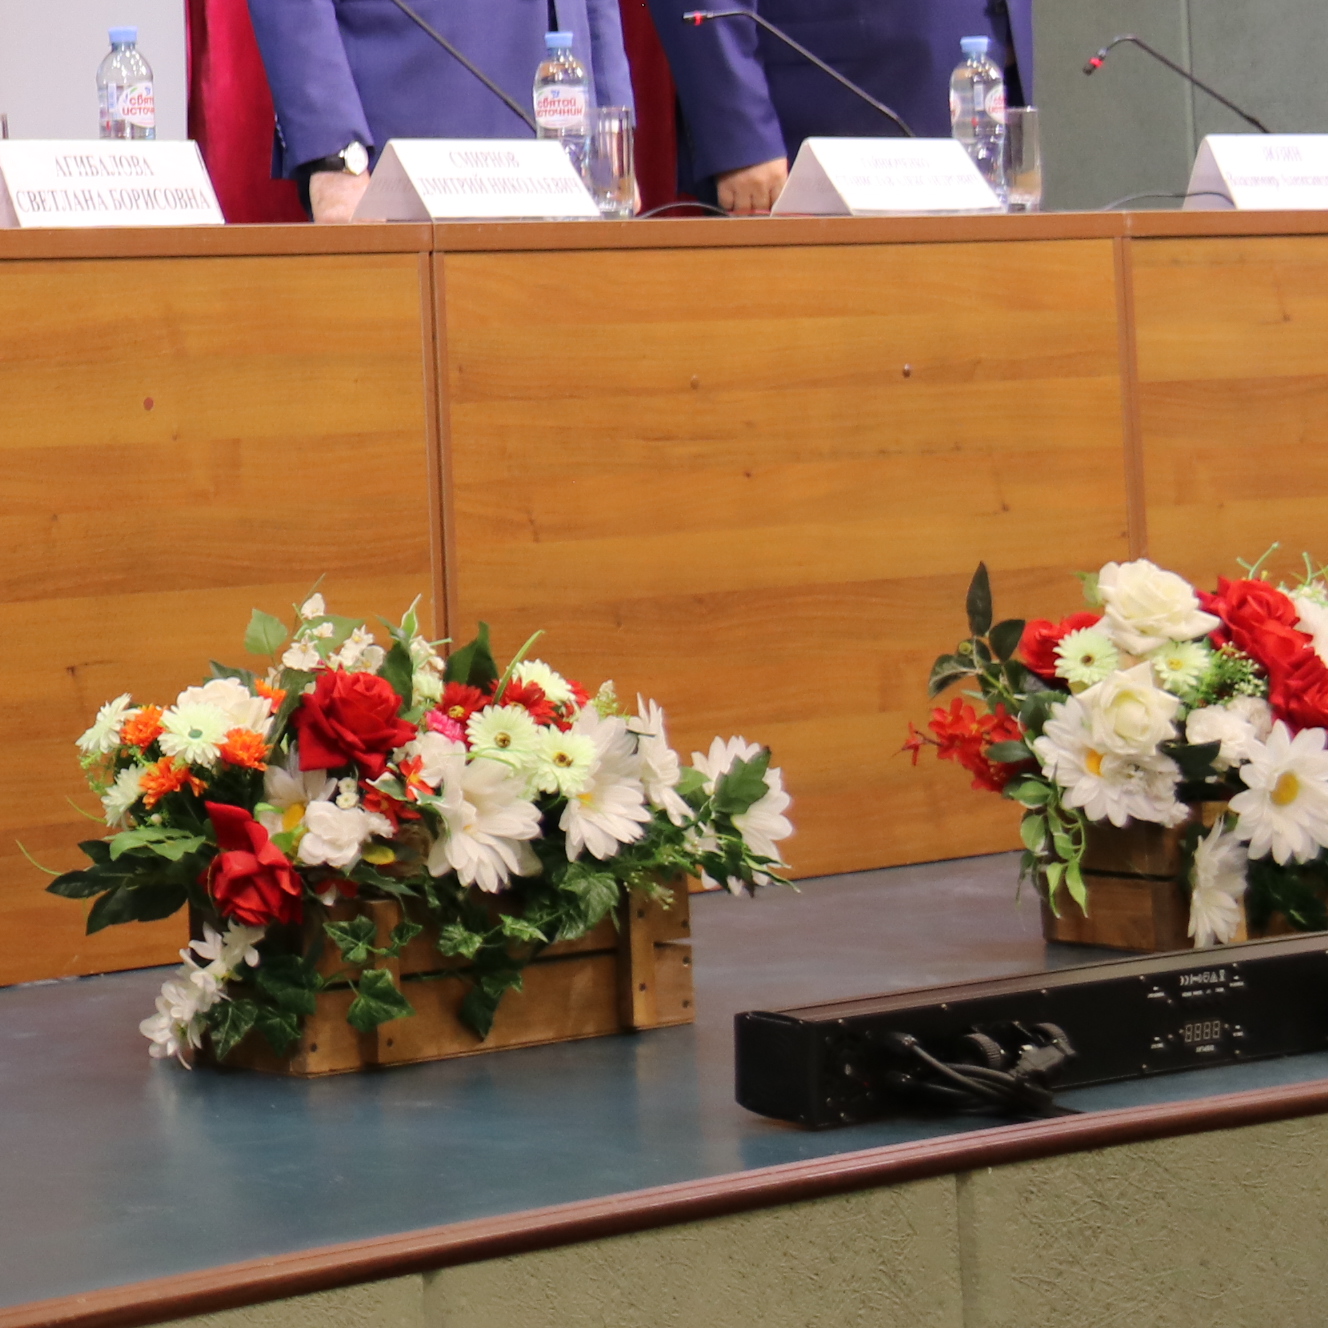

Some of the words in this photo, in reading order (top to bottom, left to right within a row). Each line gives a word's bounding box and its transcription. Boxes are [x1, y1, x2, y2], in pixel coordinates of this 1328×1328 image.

[54, 155, 156, 178] АГИБАЛОВА
[448, 151, 521, 169] СМИРНОВ
[417, 173, 489, 196] ДМИТРИЙ
[487, 176, 583, 195] НИКОЛАЕВИЧ
[15, 188, 110, 213] СВЕТЛАНА
[109, 187, 213, 212] БОРИСОВНА
